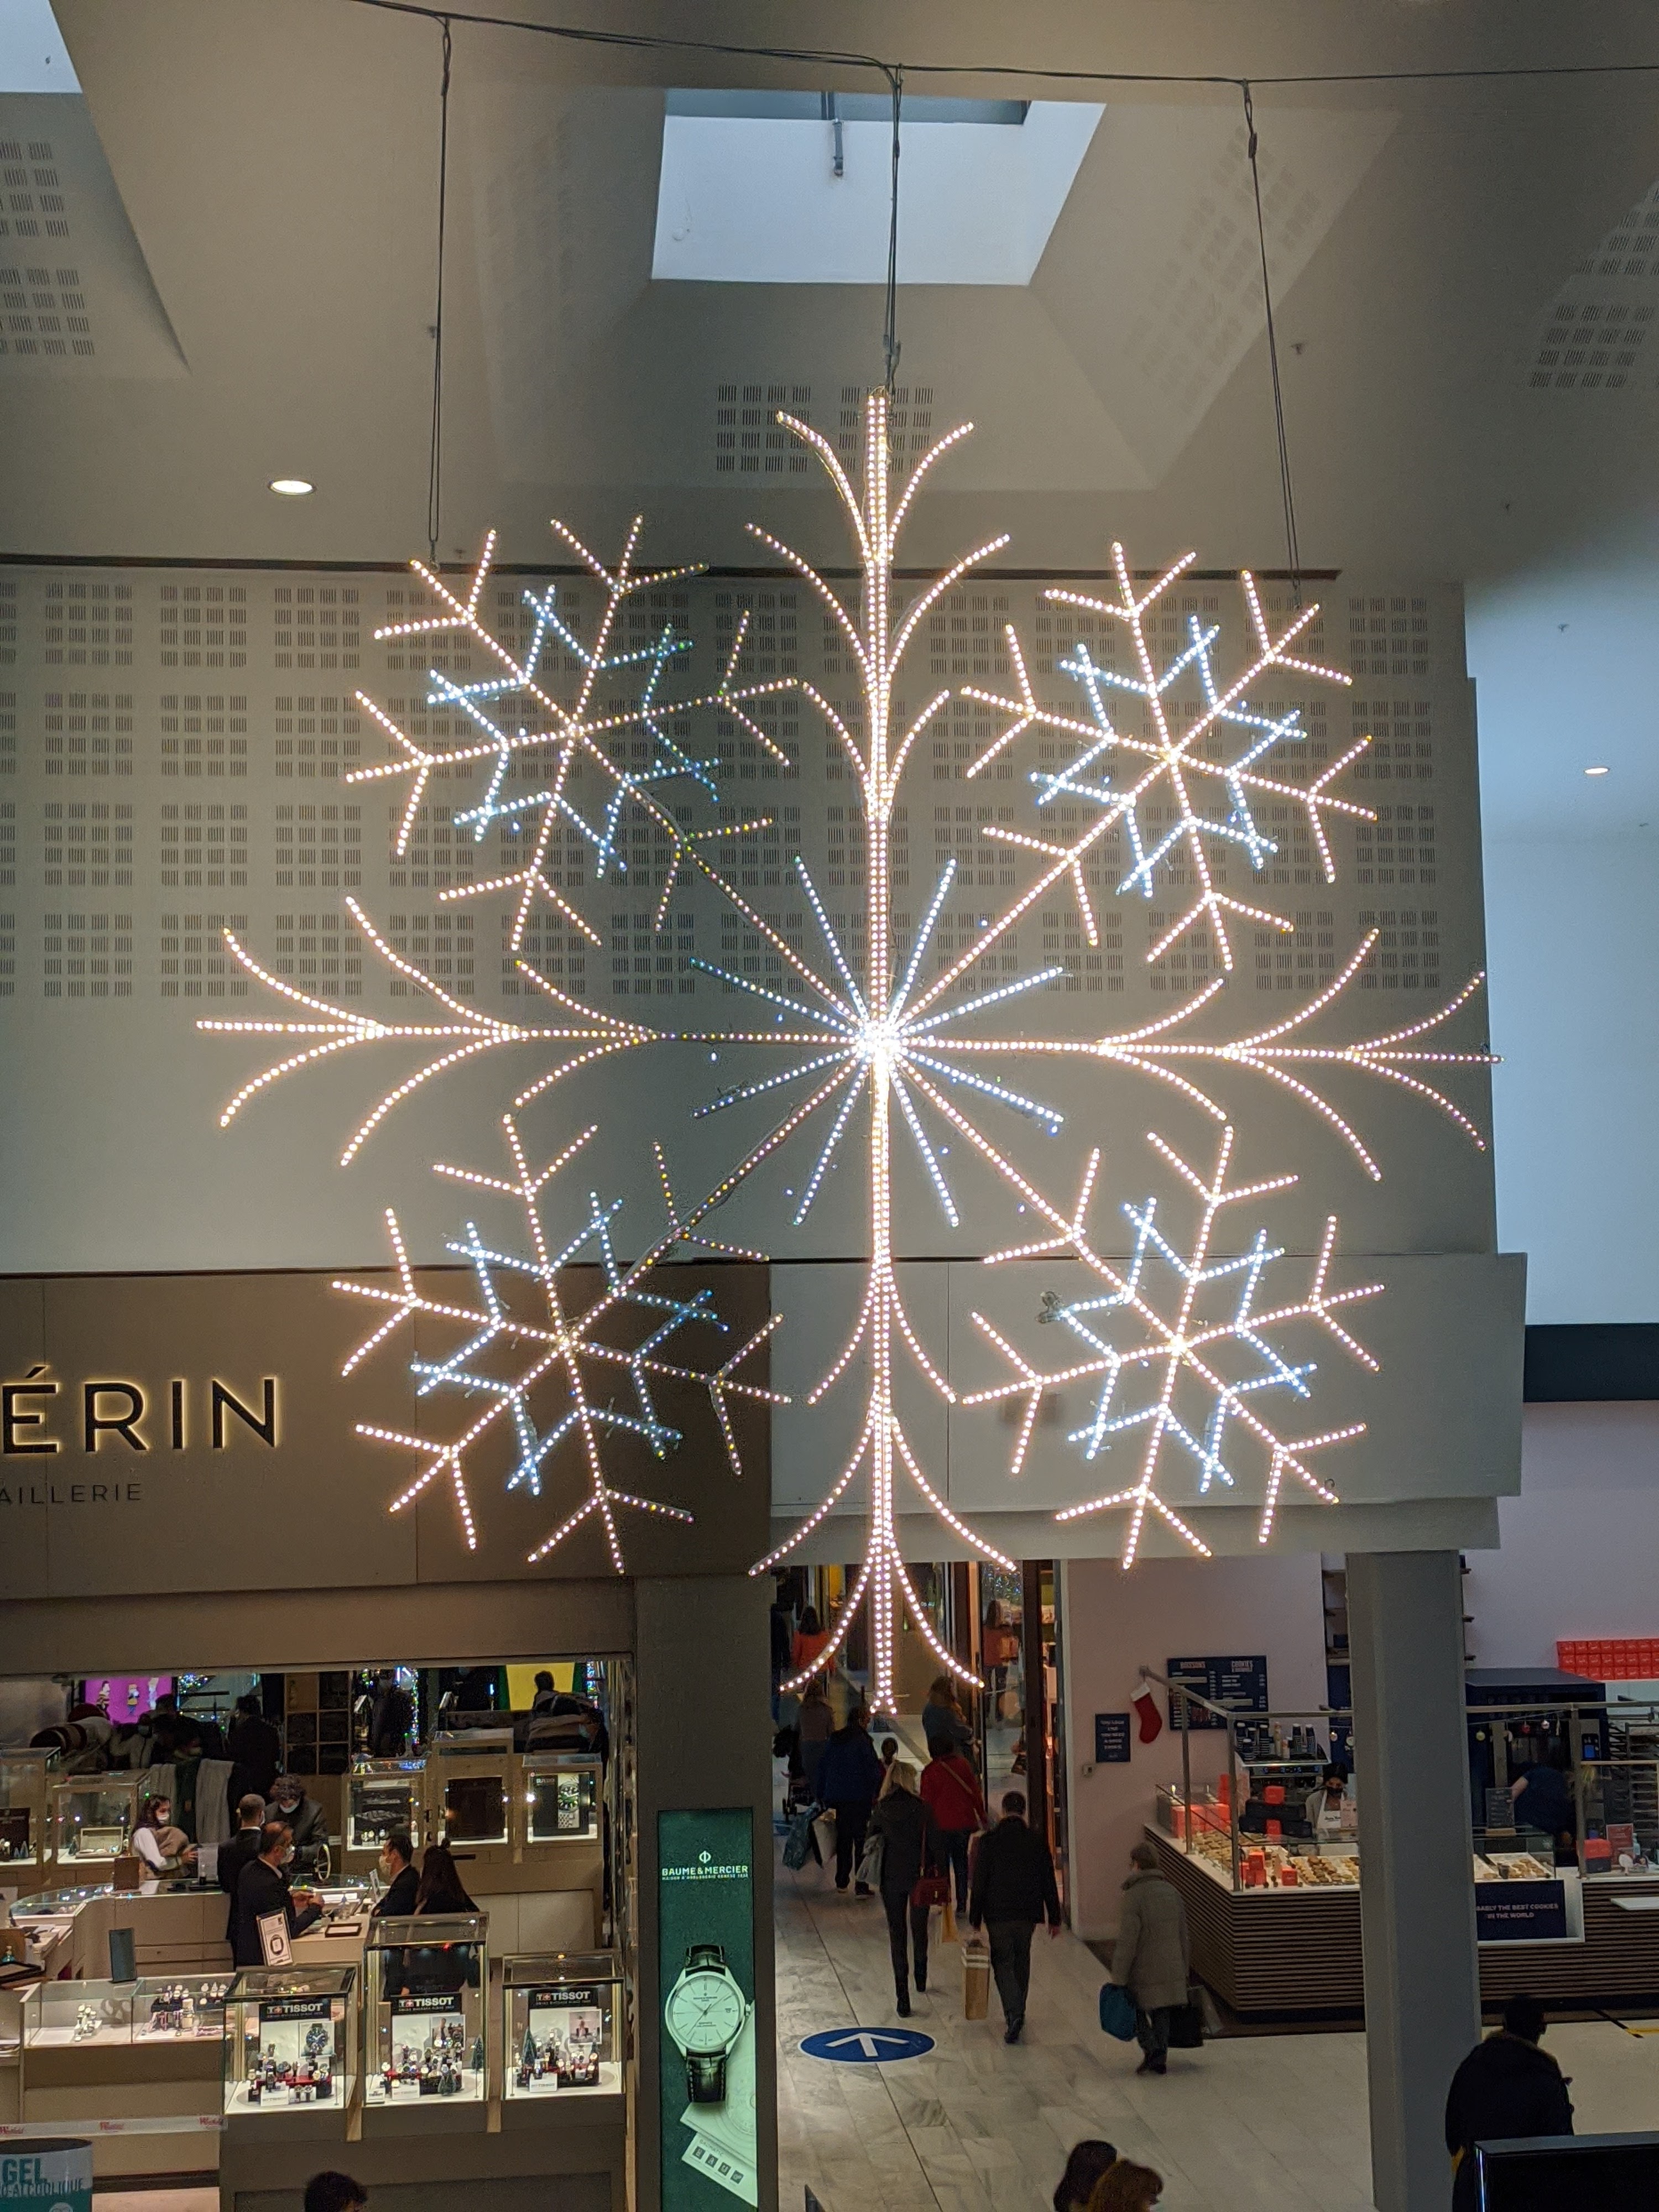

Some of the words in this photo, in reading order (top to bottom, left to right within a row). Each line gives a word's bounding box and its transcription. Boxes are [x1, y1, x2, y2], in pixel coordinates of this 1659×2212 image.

[2, 1365, 276, 1454] ÉRIN
[414, 1996, 454, 2007] TISSOT
[551, 1991, 591, 2001] TISSOT
[283, 2002, 324, 2013] TISSOT
[2, 2157, 48, 2184] GEL
